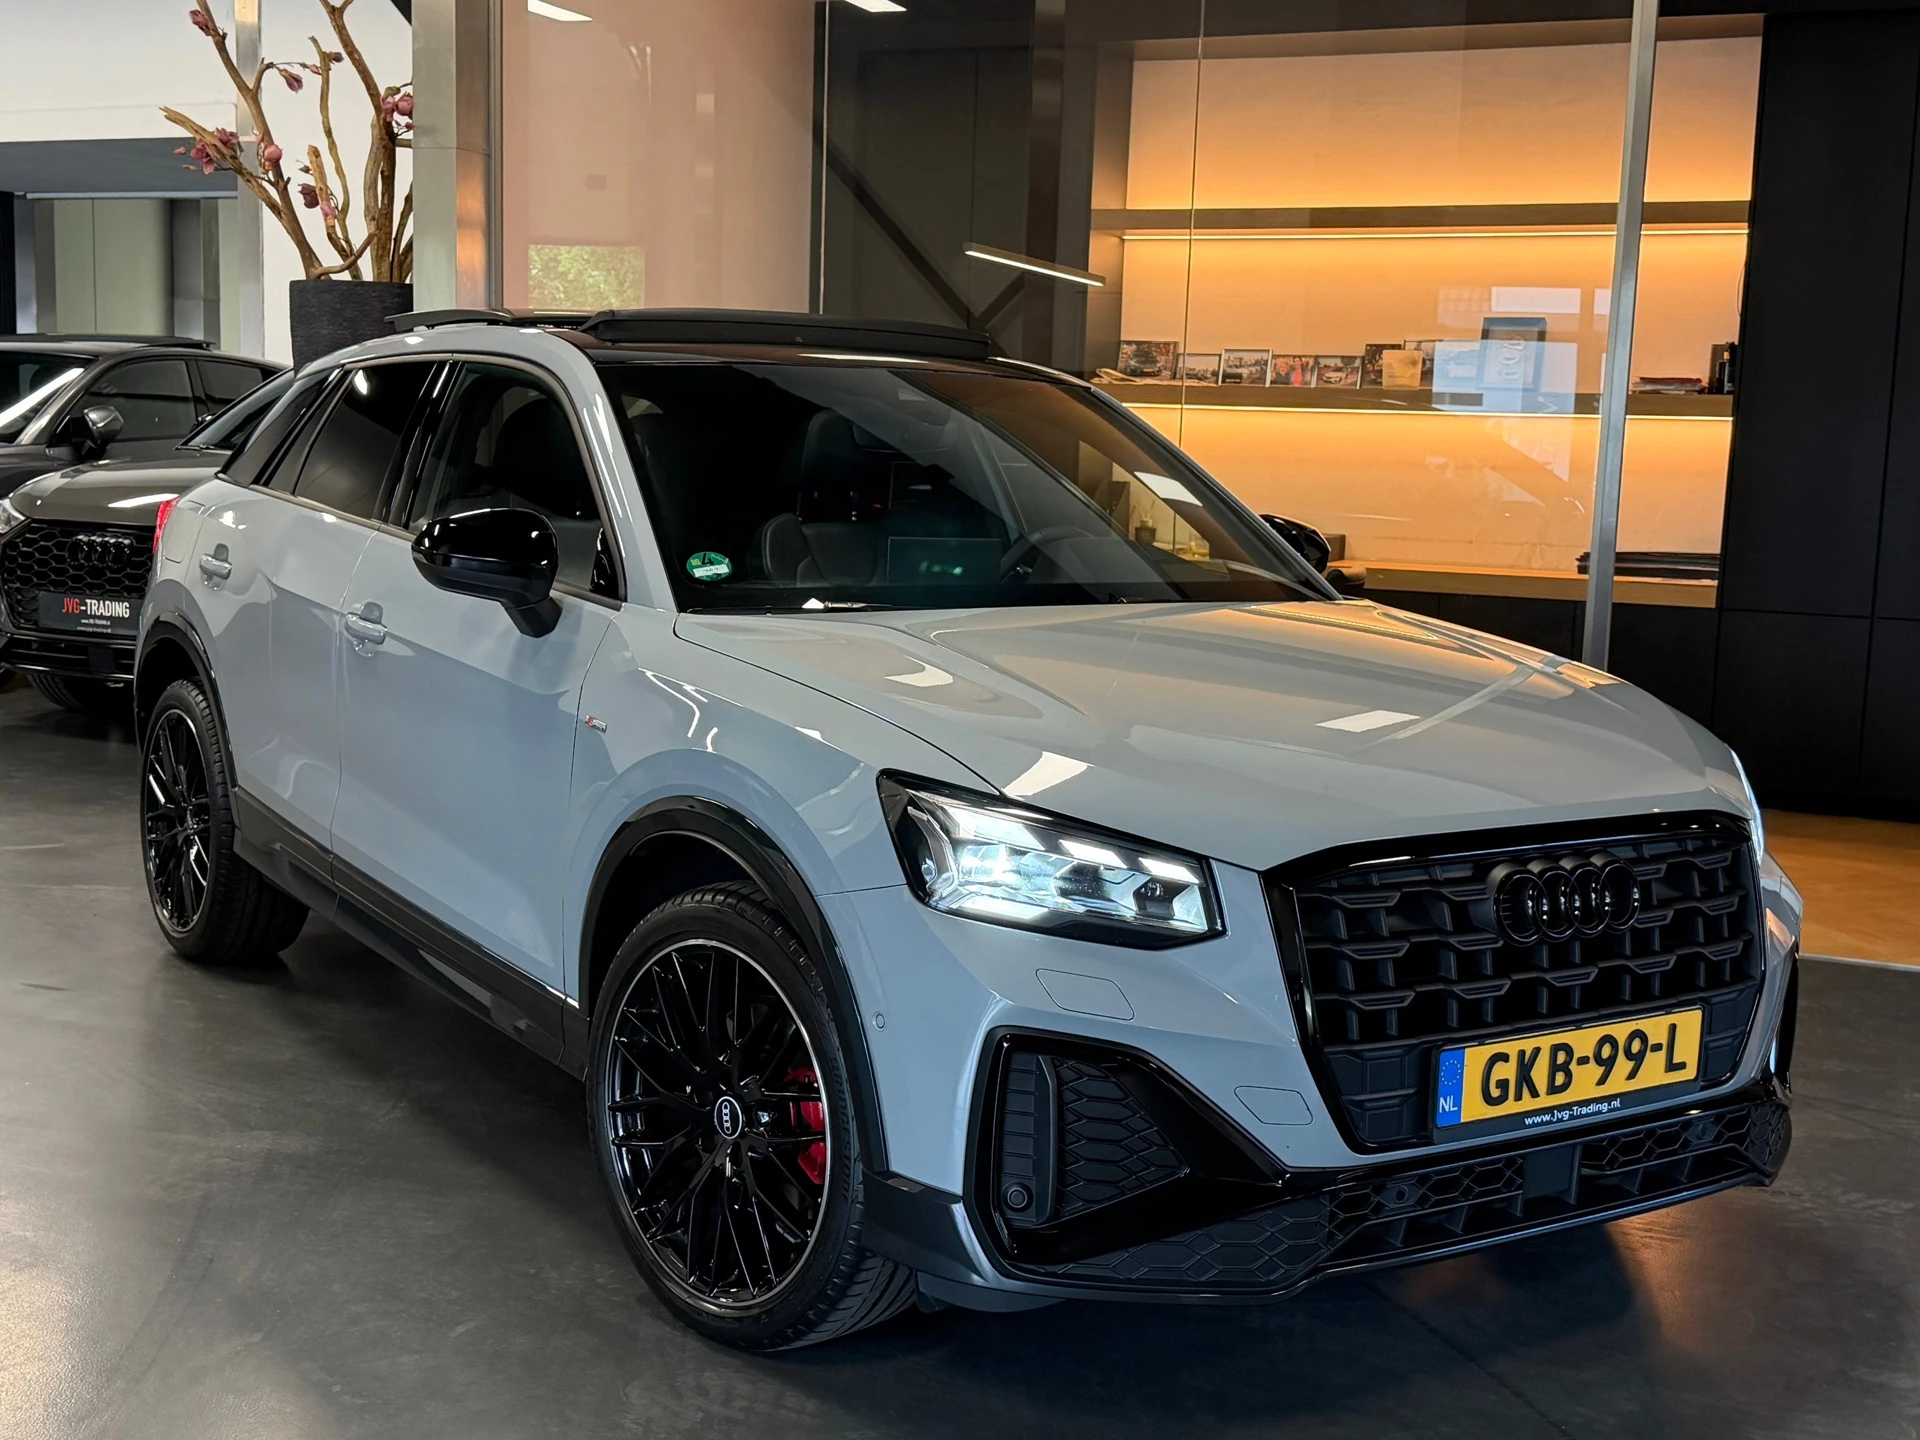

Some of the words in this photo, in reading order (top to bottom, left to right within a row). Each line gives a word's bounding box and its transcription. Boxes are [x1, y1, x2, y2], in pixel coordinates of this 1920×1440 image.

[62, 597, 130, 619] JVG-TRADING
[1481, 1022, 1687, 1107] GKB-99-L
[1438, 1095, 1459, 1114] NL
[1523, 1098, 1621, 1126] www.Jvg-Trading.nl
